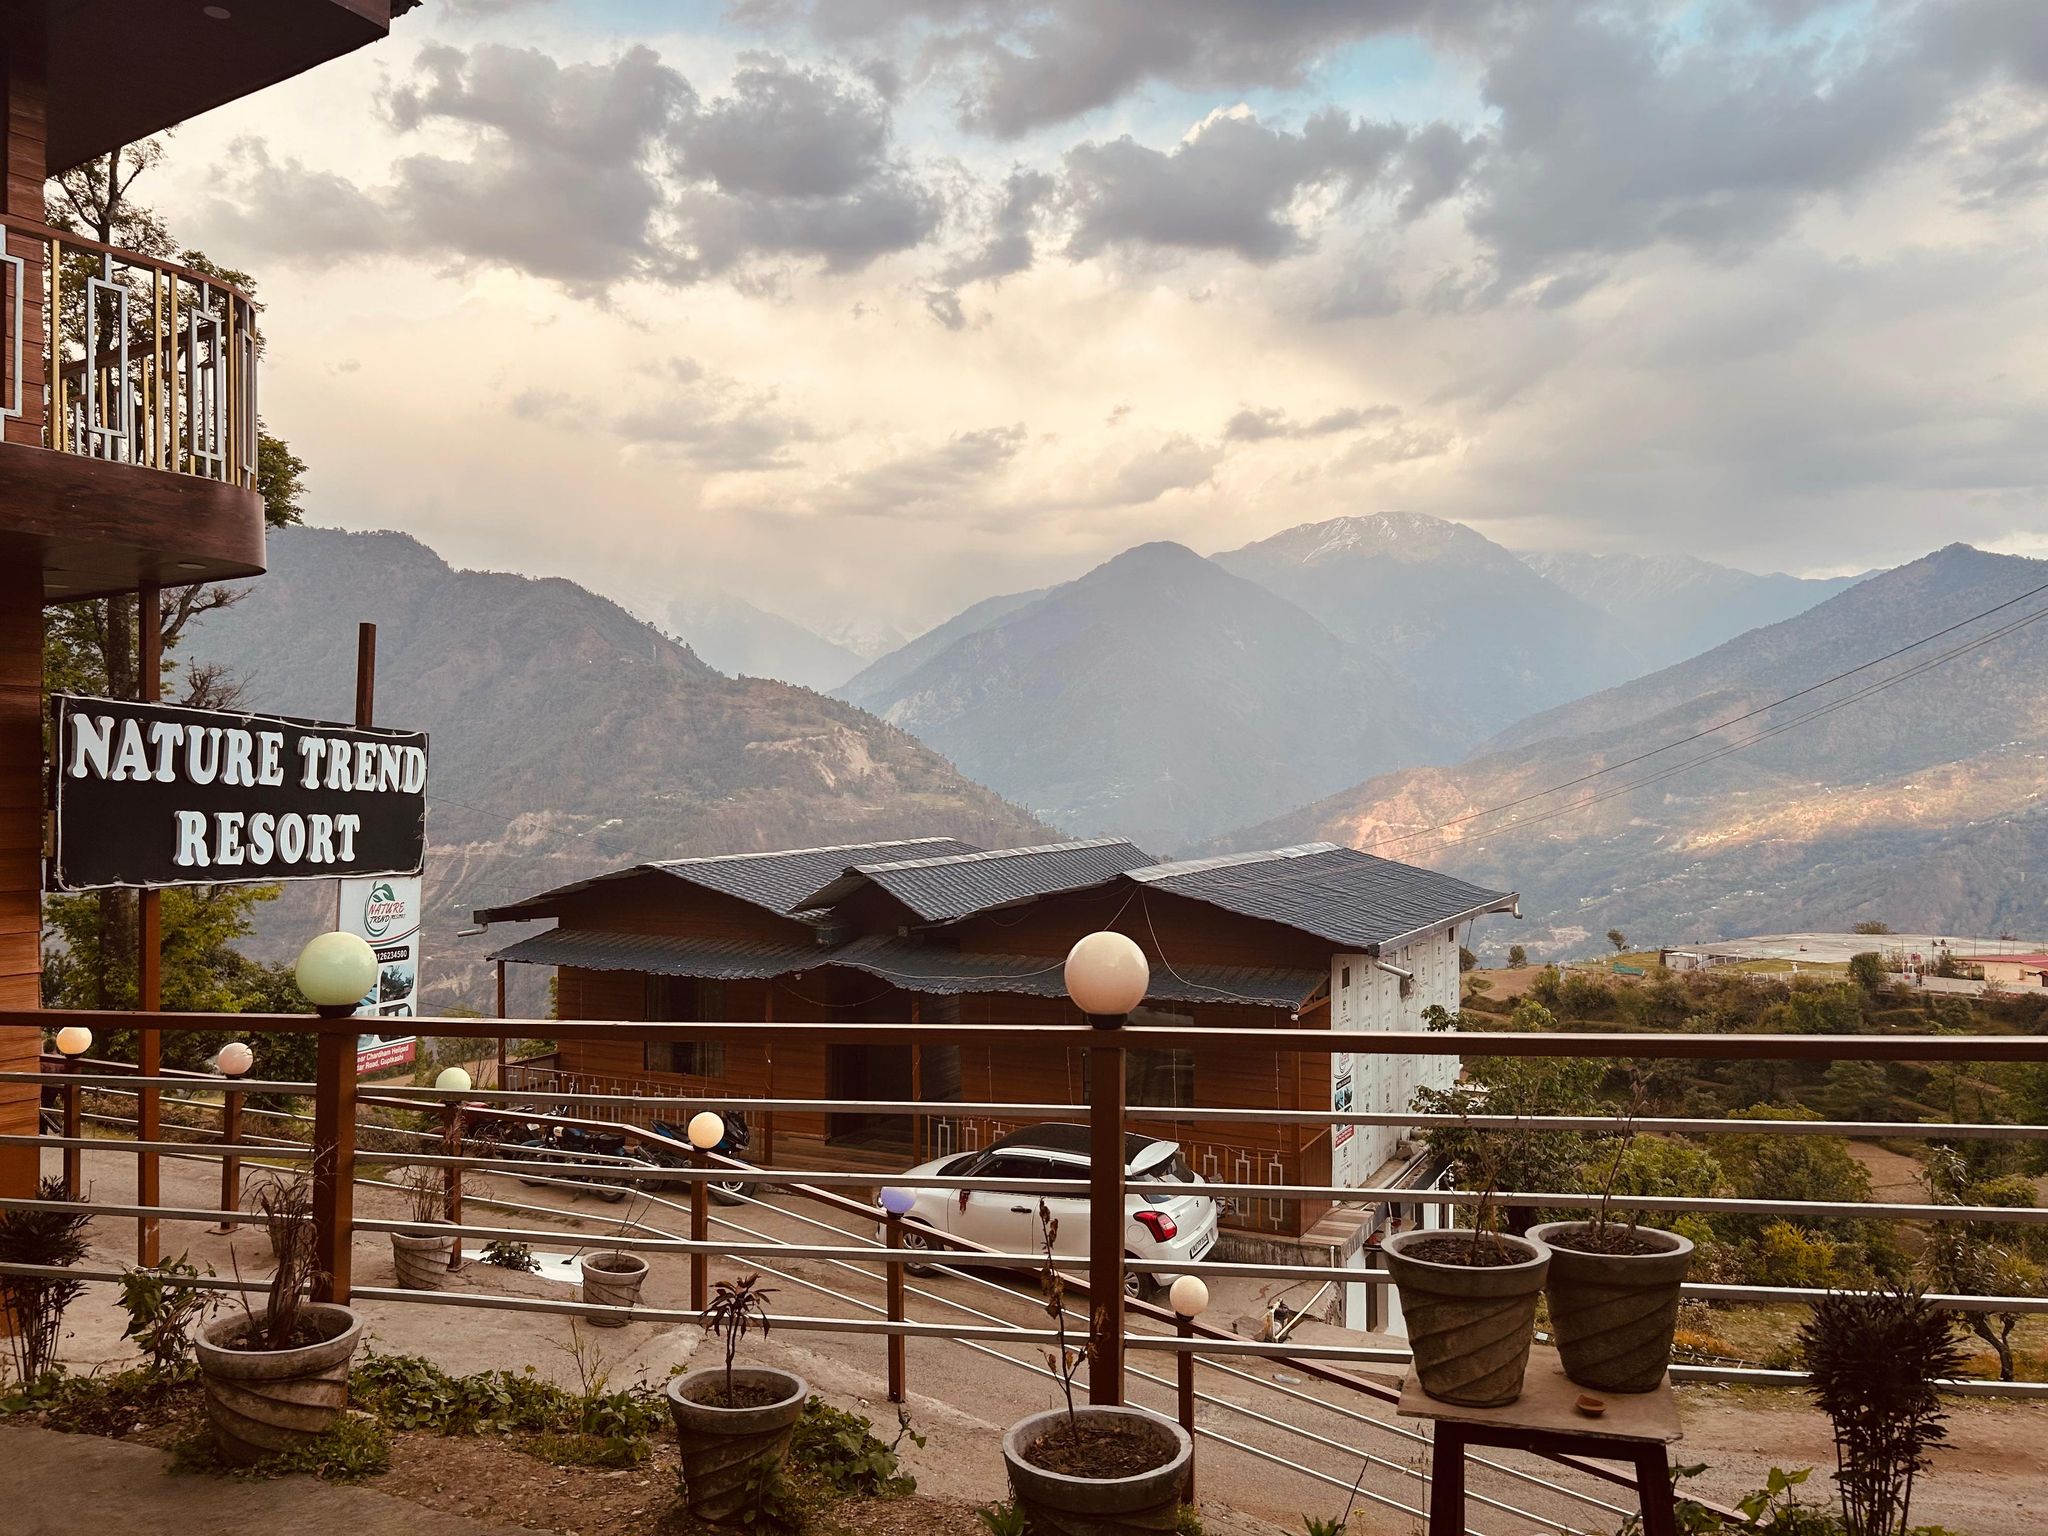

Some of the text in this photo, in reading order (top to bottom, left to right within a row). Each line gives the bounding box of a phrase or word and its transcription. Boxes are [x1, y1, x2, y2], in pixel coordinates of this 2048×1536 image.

[68, 713, 426, 793] NATURE TREND
[173, 810, 361, 867] RESORT
[369, 902, 405, 915] NATURE
[370, 915, 390, 924] TREND
[376, 949, 407, 960] 126234500
